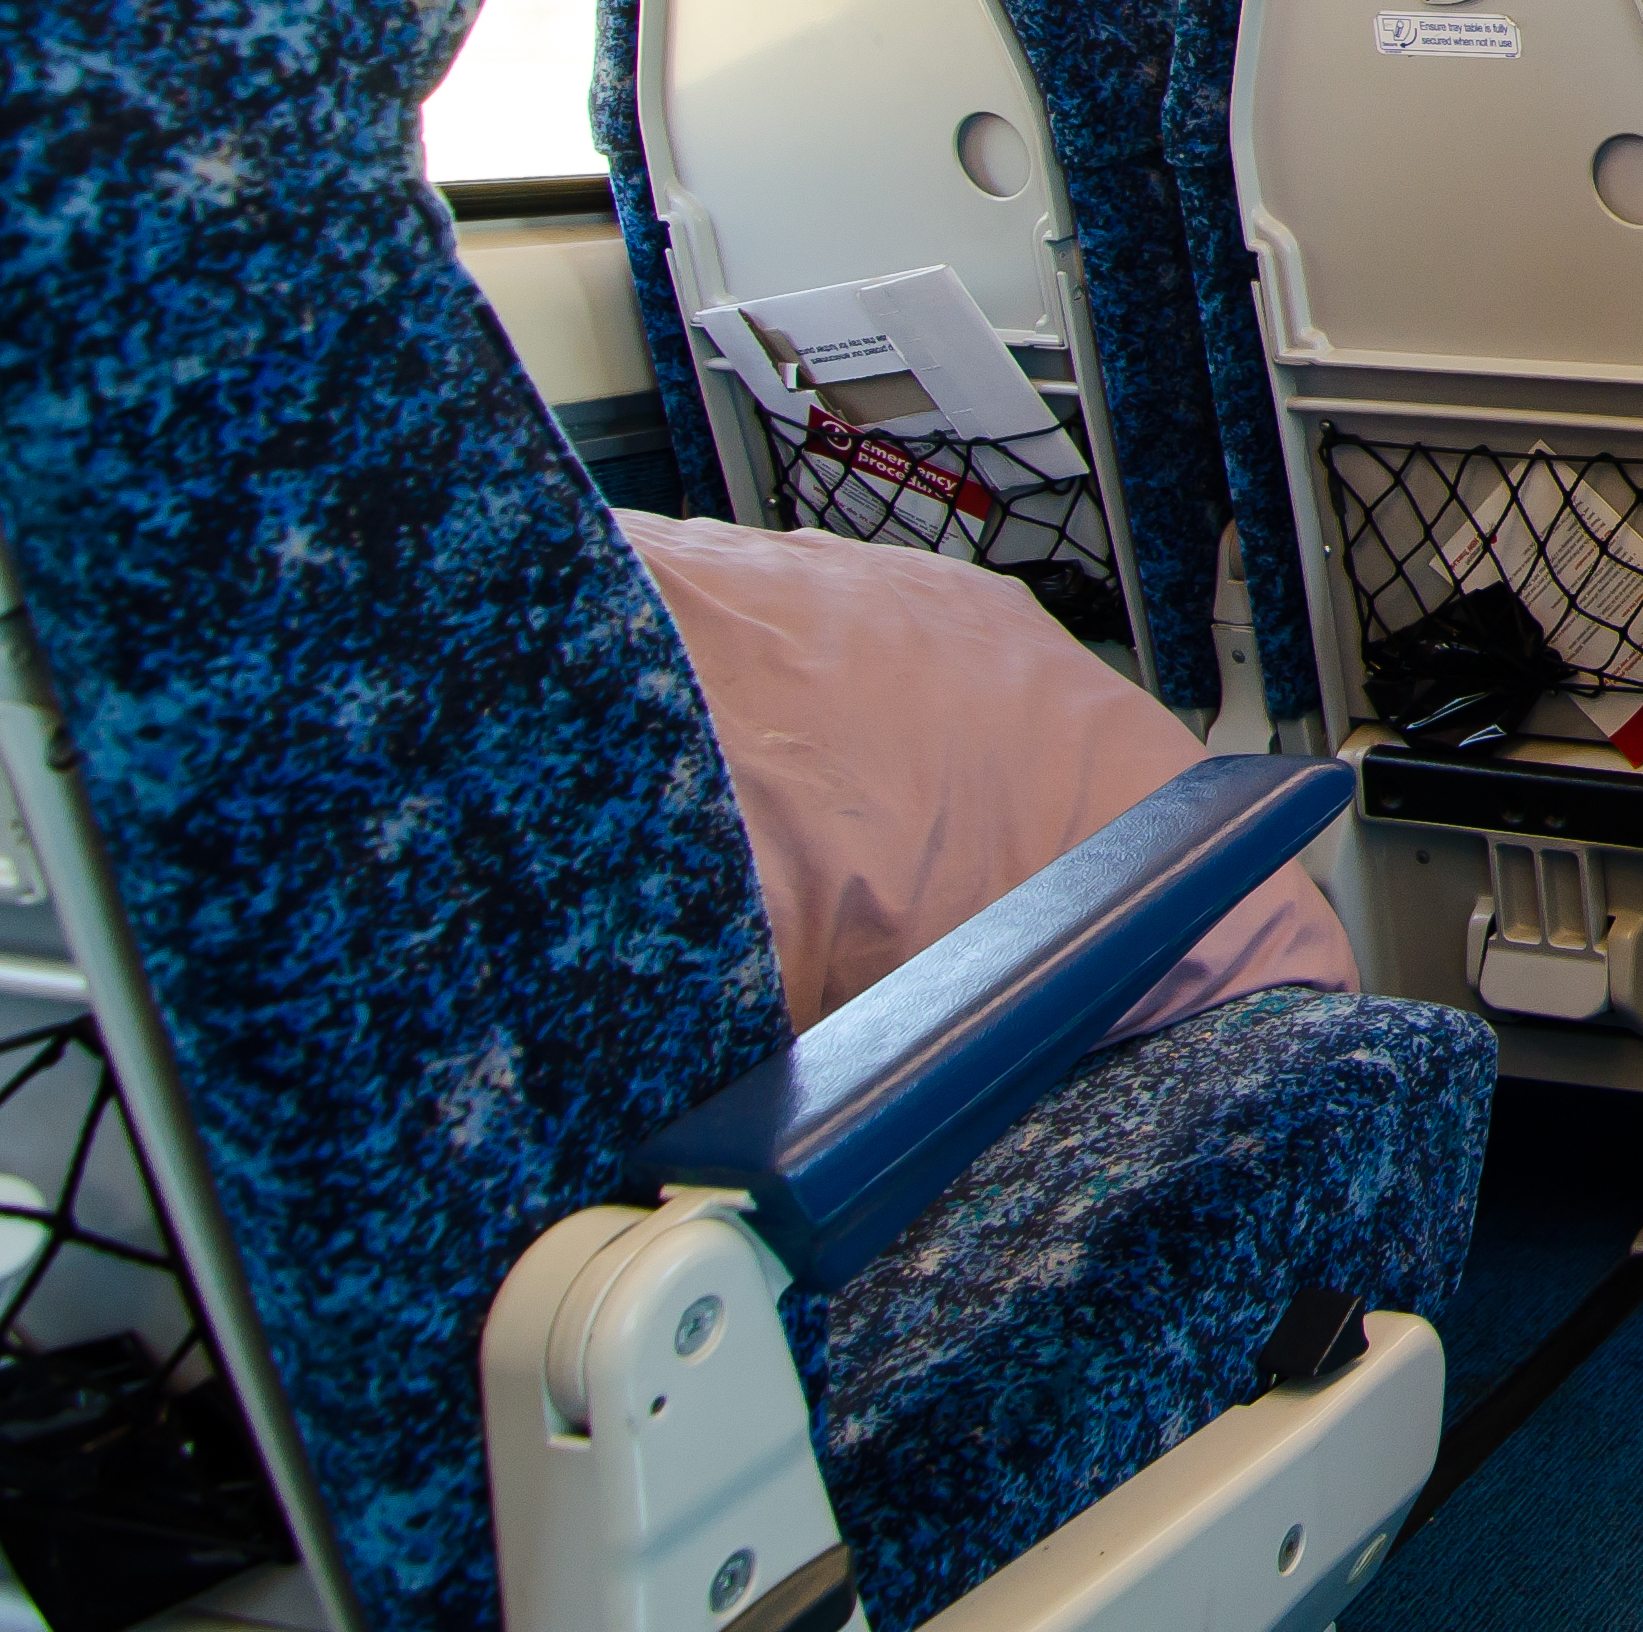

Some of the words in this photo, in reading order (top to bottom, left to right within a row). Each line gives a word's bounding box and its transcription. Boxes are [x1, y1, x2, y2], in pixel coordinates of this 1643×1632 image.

[1420, 21, 1447, 31] Ensure
[1448, 23, 1462, 34] tray
[1464, 23, 1483, 33] table
[1485, 24, 1492, 33] is
[1493, 24, 1508, 36] fully
[1421, 37, 1452, 46] secured
[1453, 38, 1475, 46] when
[1476, 38, 1488, 47] not
[1490, 38, 1497, 47] in
[1499, 39, 1512, 48] use
[858, 451, 954, 499] procedur
[860, 439, 958, 491] Emergency
